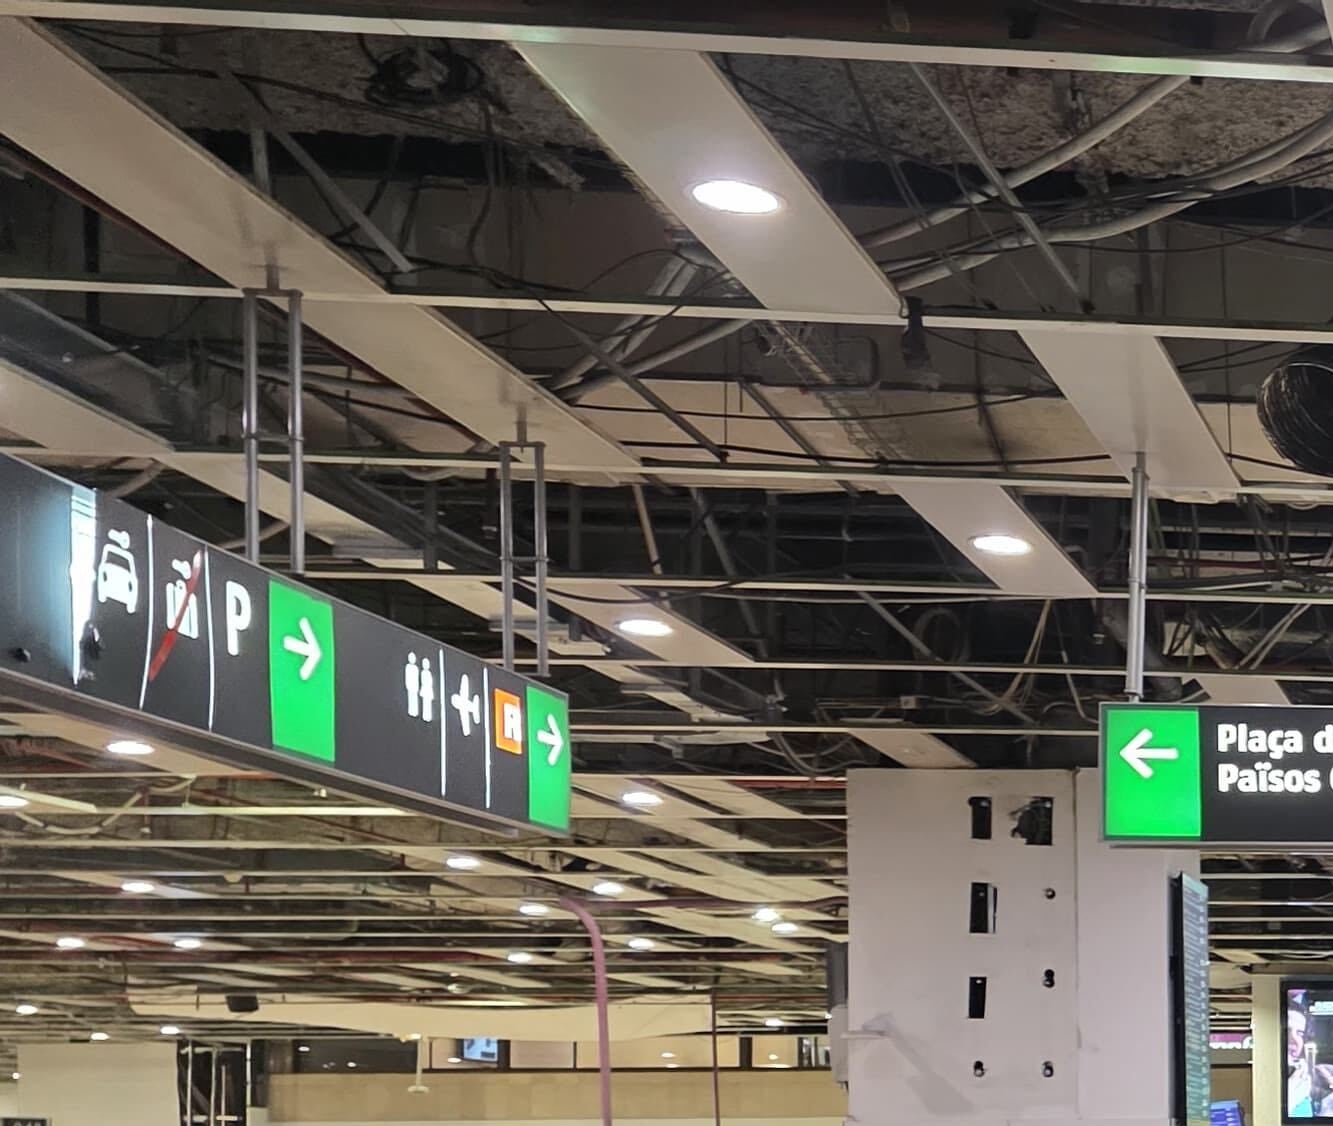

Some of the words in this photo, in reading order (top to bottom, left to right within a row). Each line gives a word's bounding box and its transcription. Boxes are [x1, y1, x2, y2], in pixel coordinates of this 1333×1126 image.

[226, 580, 252, 656] P
[1217, 722, 1304, 759] Plaça
[1217, 761, 1322, 794] Països
